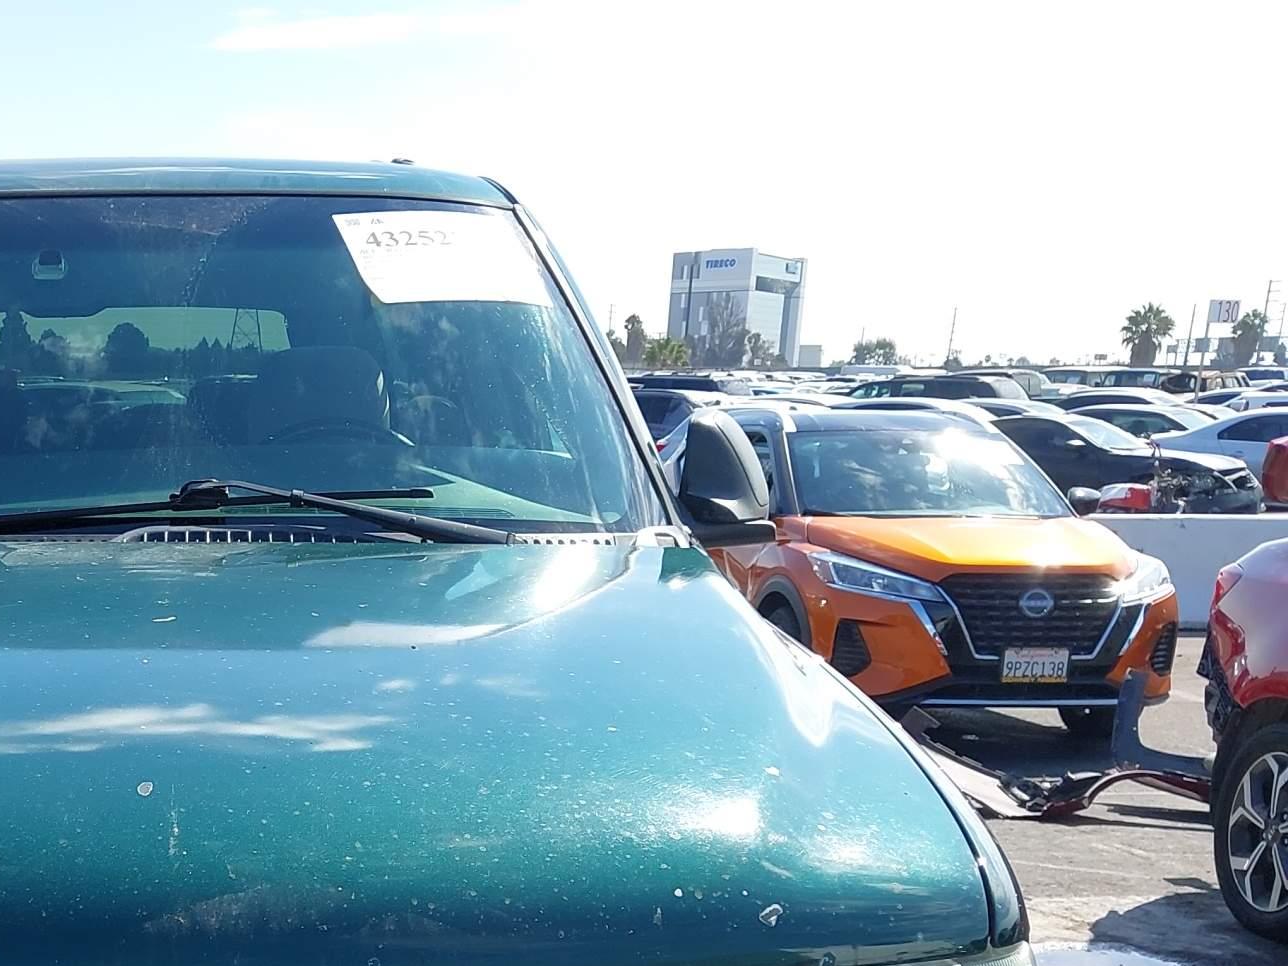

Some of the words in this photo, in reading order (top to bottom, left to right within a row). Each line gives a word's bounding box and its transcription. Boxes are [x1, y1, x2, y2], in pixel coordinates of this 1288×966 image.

[705, 258, 736, 269] TIRECO
[1217, 300, 1240, 322] 130
[1005, 660, 1065, 678] 9PZC138
